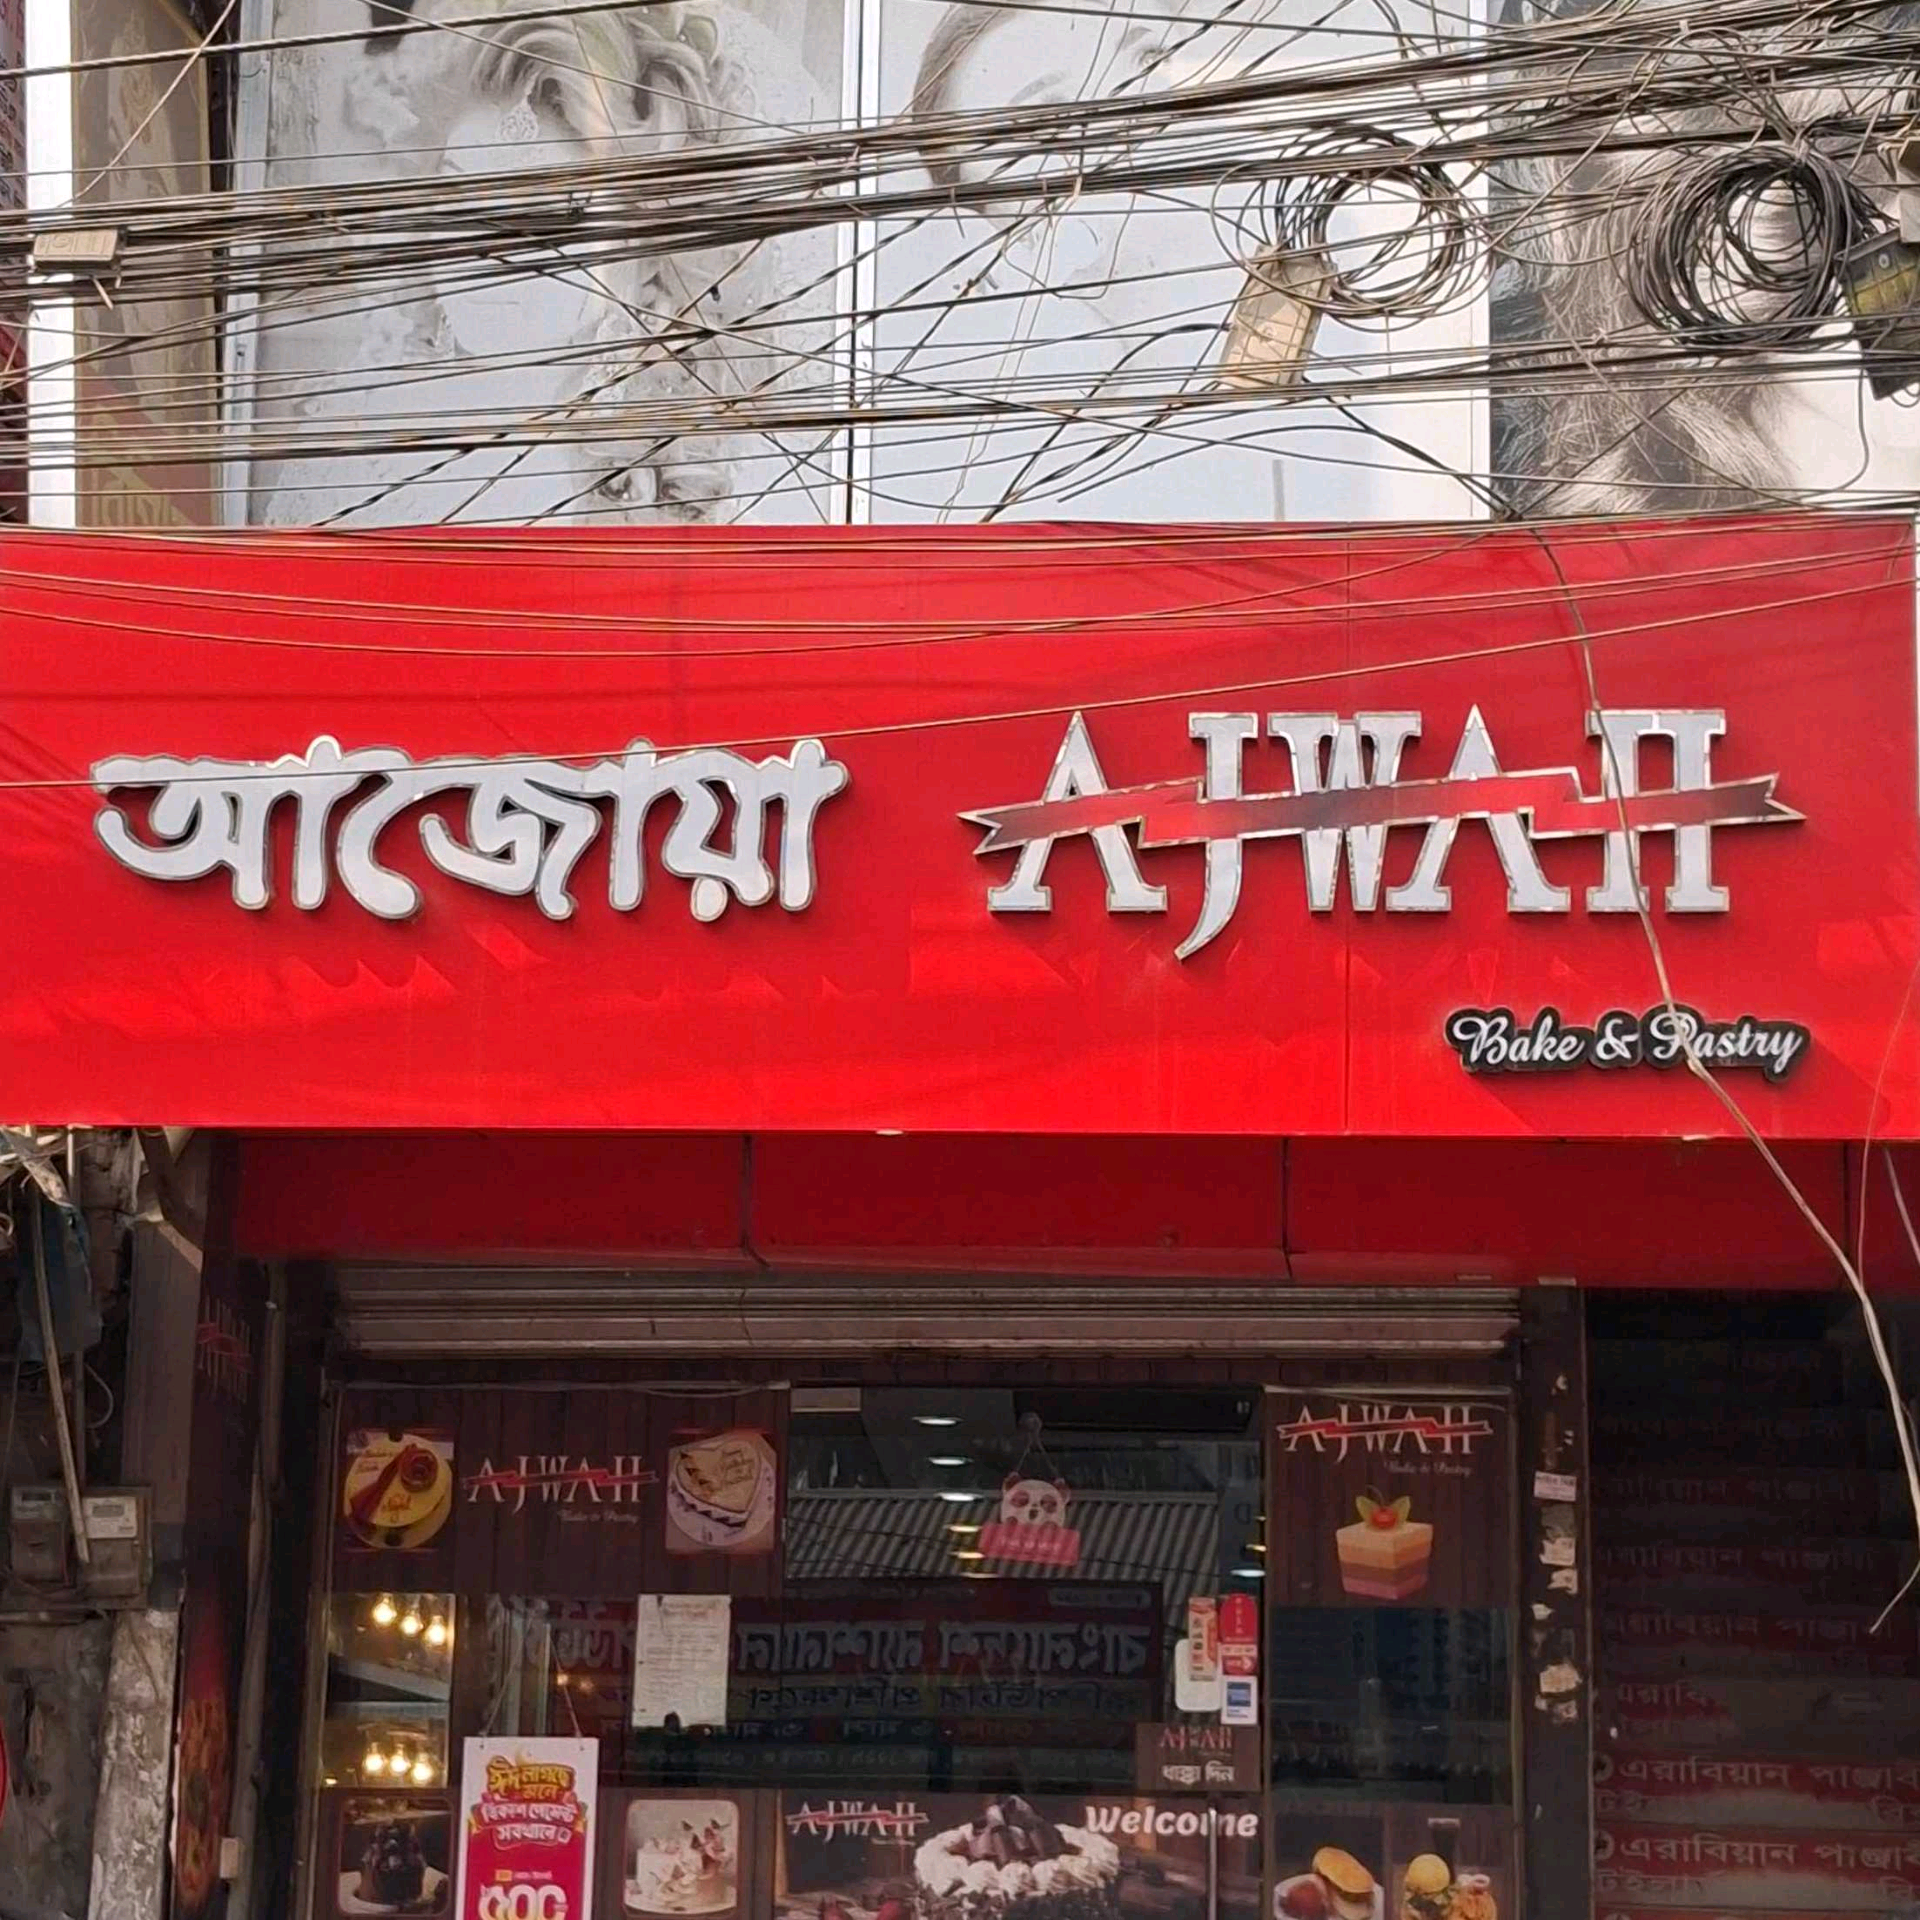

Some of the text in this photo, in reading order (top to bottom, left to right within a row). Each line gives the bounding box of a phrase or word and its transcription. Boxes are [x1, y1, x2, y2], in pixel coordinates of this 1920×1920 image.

[92, 734, 849, 920] আজোয়া
[986, 703, 1729, 959] AJWAH
[1453, 1011, 1804, 1074] Bake & Pastry
[1284, 1404, 1472, 1463] AJWAH
[467, 1454, 641, 1513] AJWAH
[1161, 1759, 1236, 1785] ধাক্কা দিন
[790, 1800, 917, 1842] AJWAH
